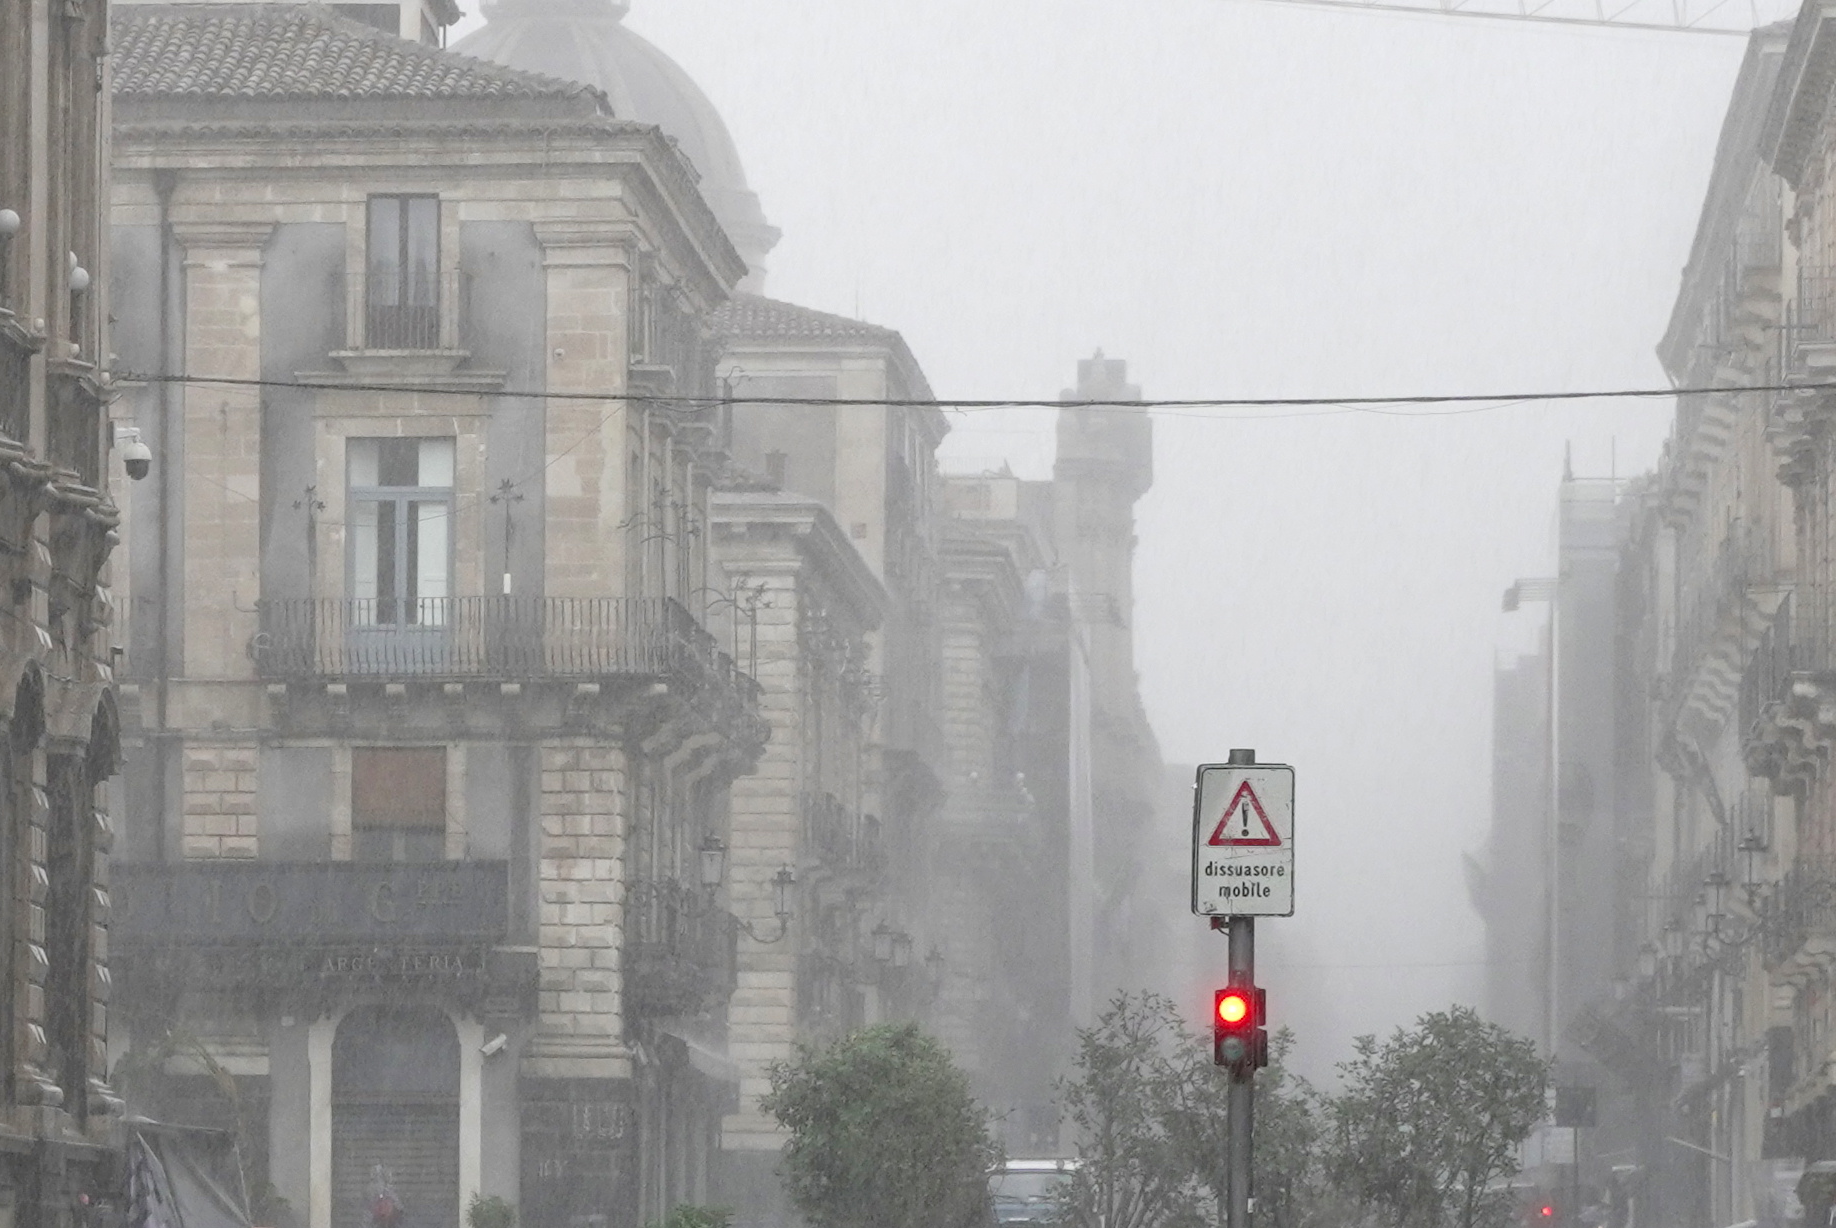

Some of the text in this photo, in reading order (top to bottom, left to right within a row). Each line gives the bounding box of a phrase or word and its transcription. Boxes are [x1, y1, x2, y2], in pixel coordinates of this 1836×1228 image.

[1205, 861, 1285, 877] dissuasore
[1219, 882, 1271, 898] mobile
[323, 955, 464, 972] ARGETERIA
